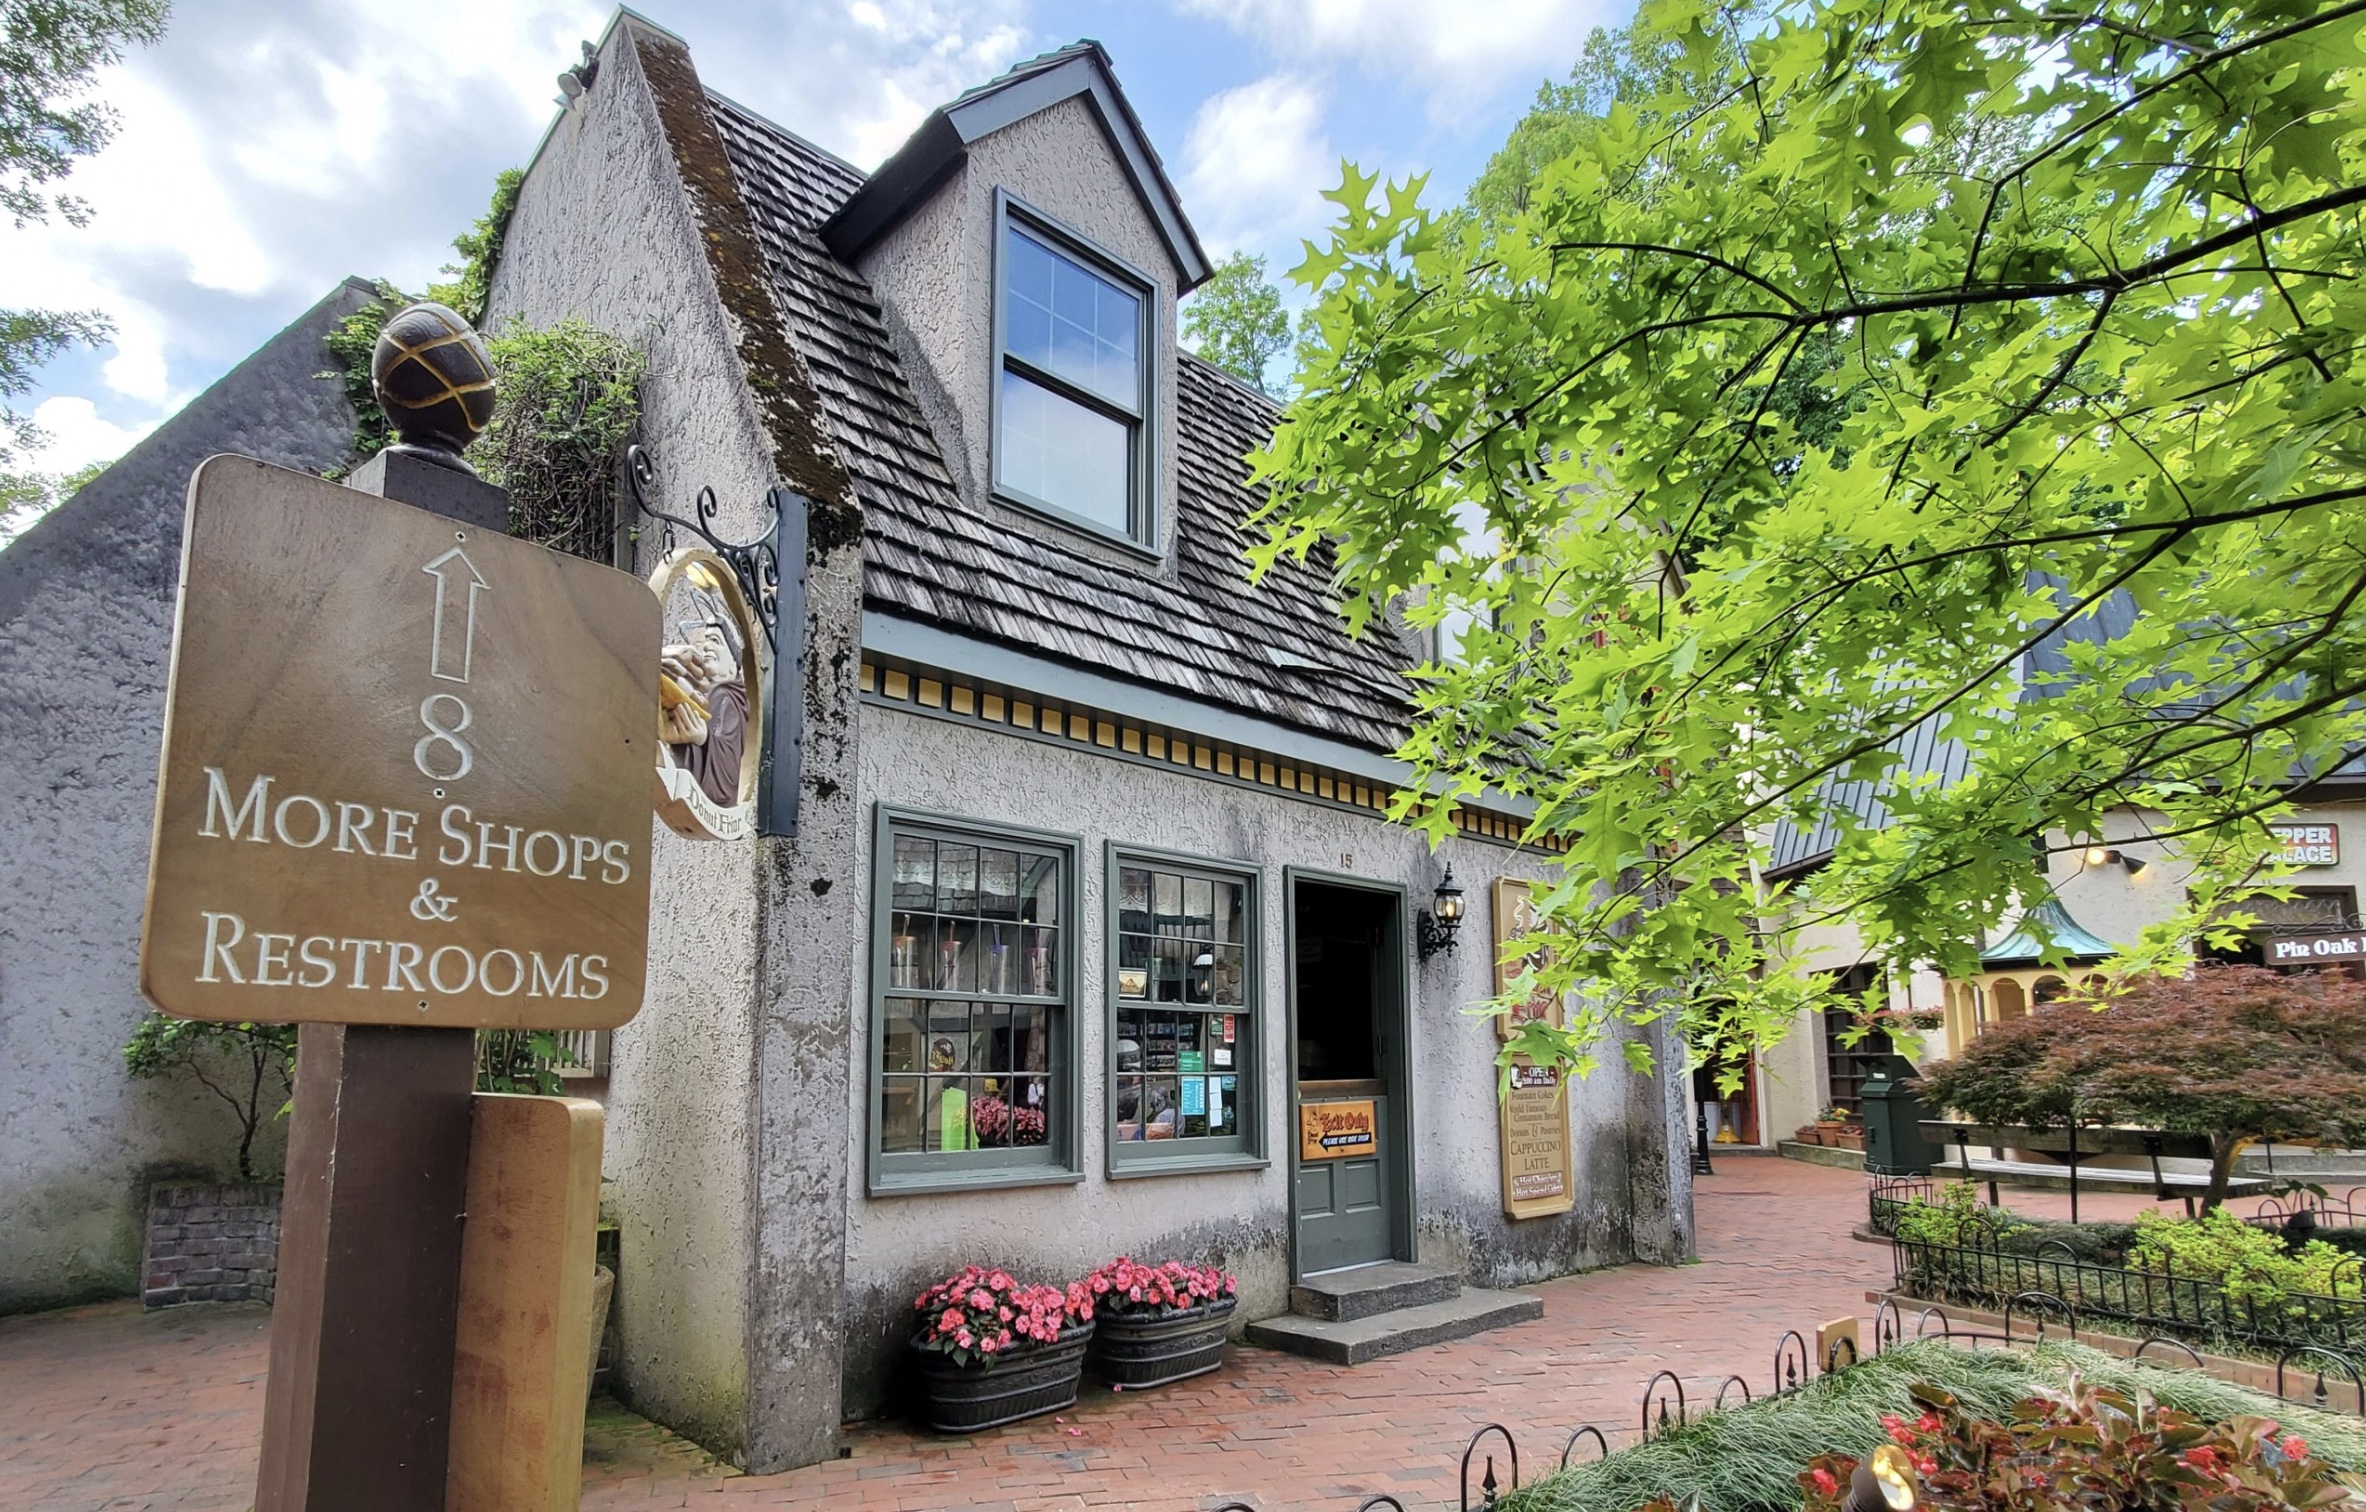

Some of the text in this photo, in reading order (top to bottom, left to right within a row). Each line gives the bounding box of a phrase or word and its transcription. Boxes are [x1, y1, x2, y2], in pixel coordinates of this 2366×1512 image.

[413, 694, 473, 781] 8
[686, 784, 718, 830] Donut
[1340, 852, 1353, 869] 15
[2267, 845, 2332, 863] ALACE
[410, 877, 459, 922] &
[2275, 940, 2311, 959] Pin
[2313, 937, 2358, 956] Oak
